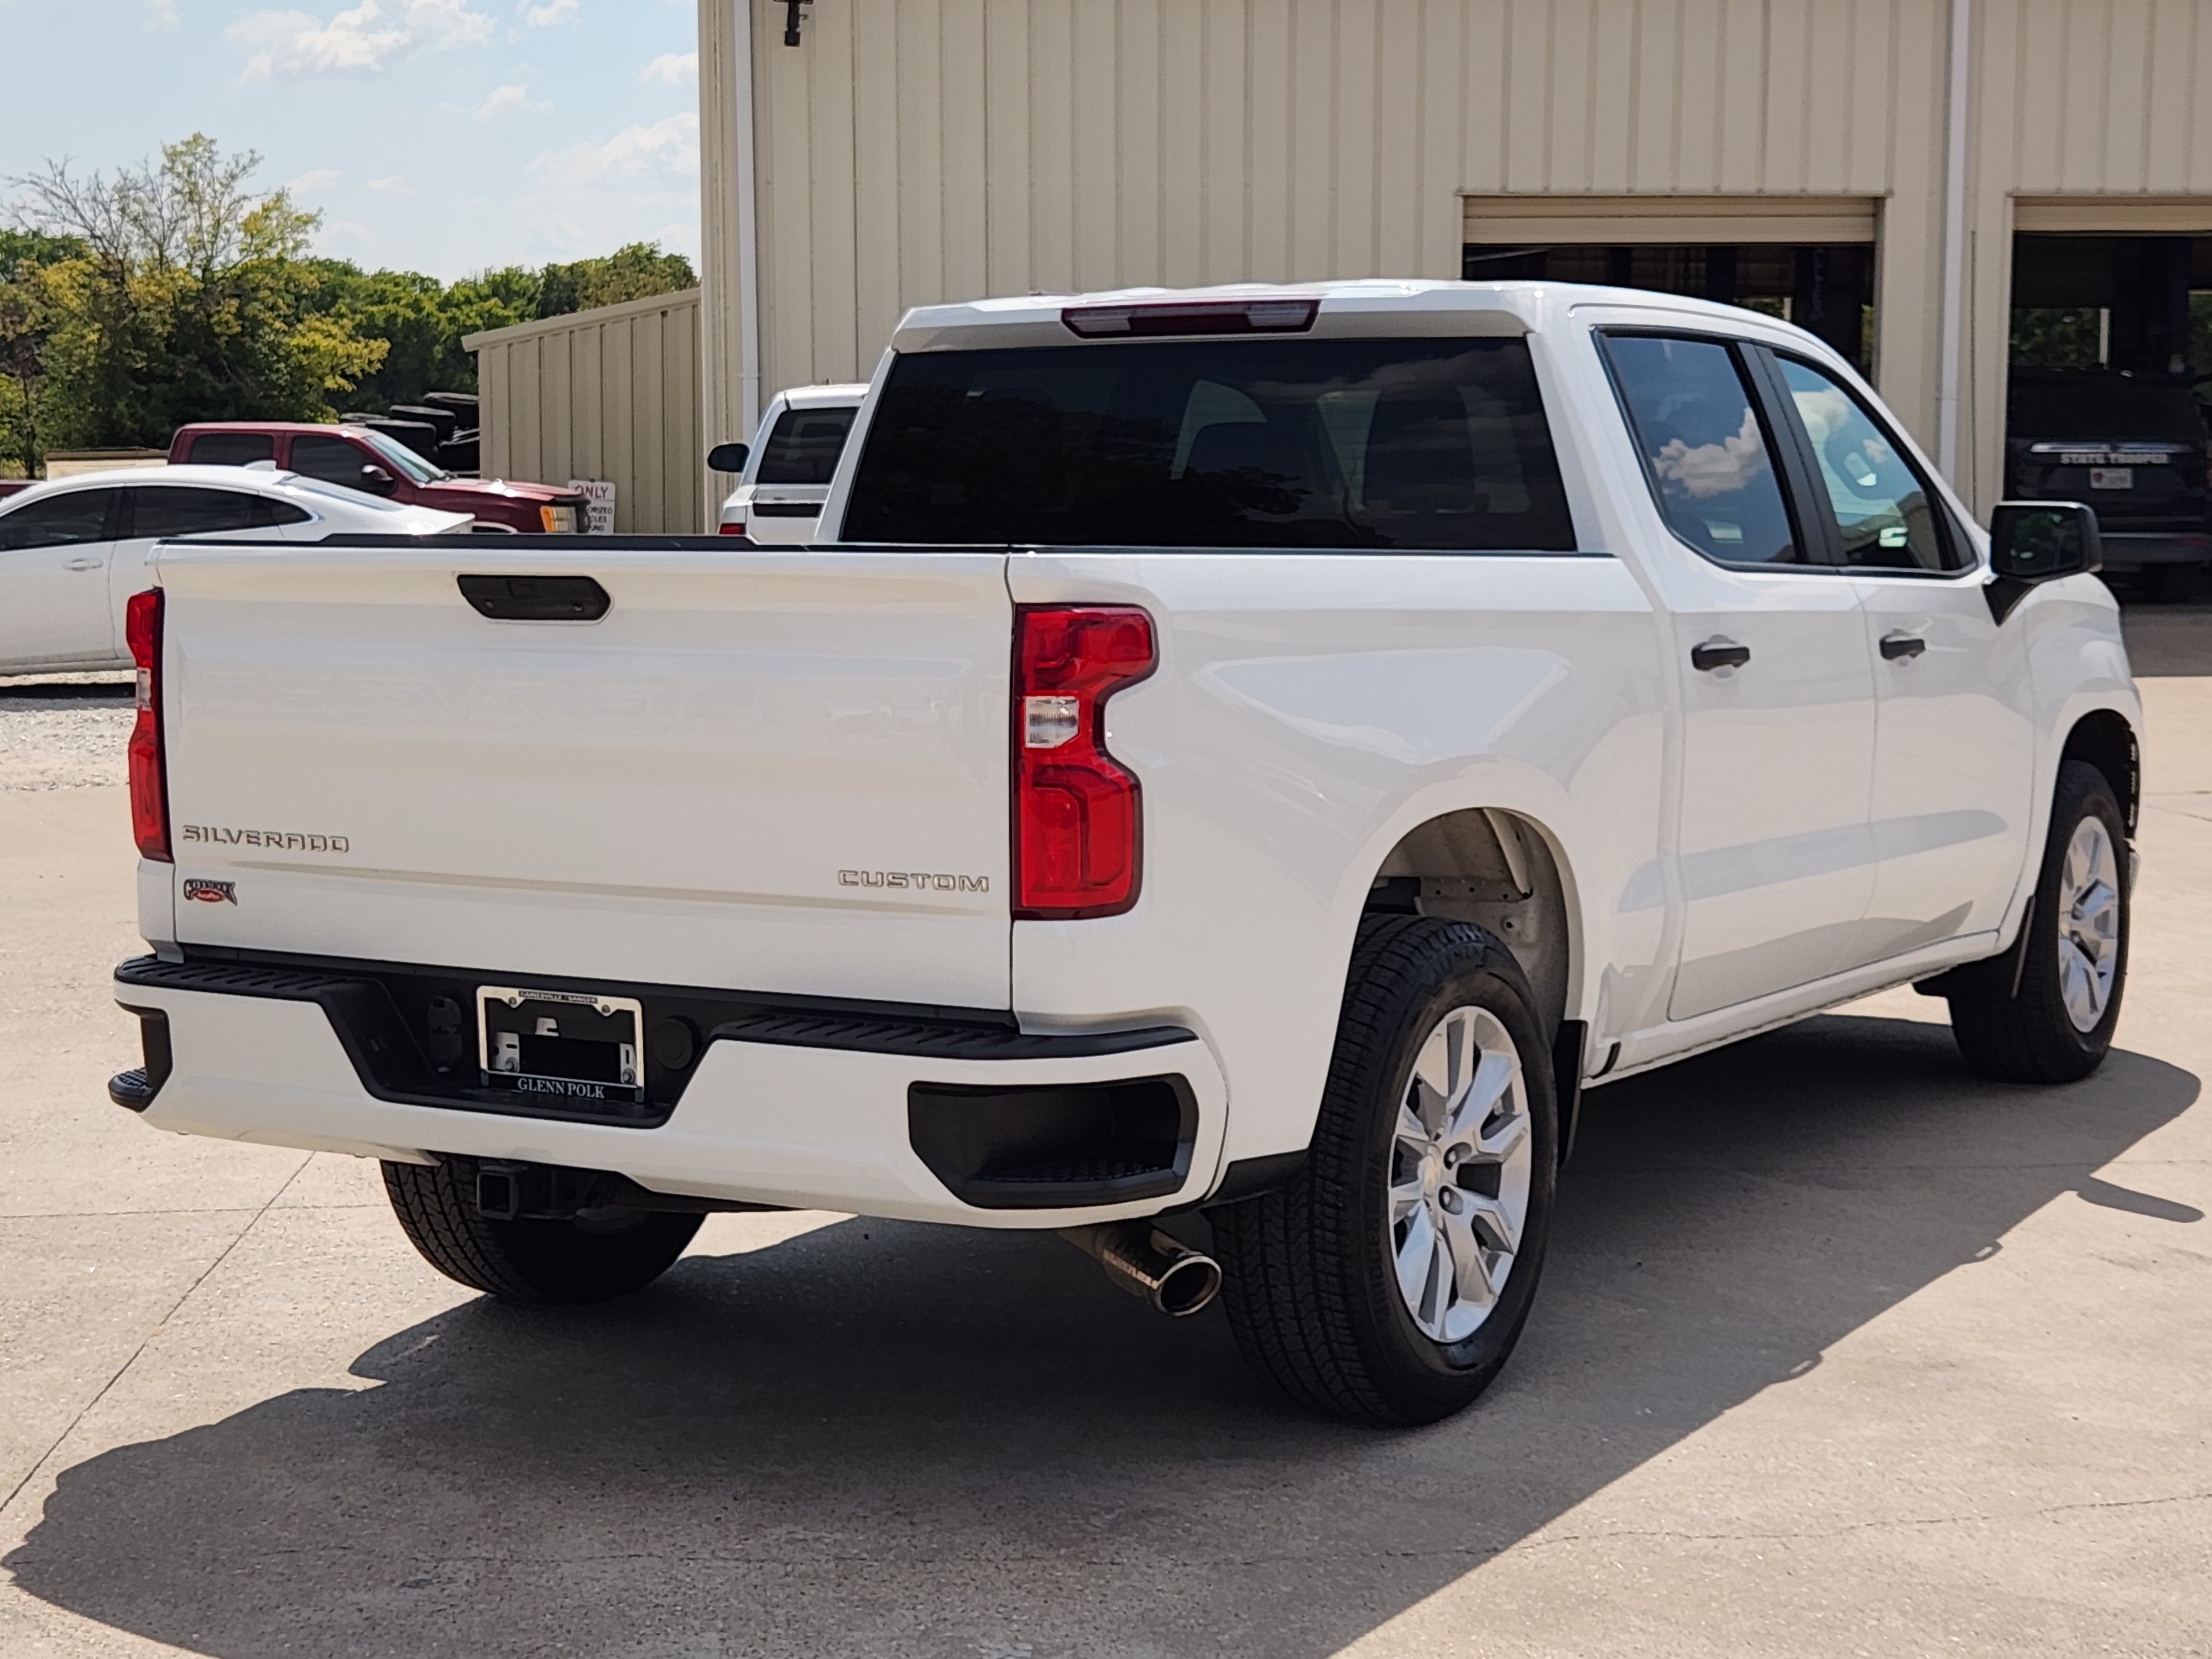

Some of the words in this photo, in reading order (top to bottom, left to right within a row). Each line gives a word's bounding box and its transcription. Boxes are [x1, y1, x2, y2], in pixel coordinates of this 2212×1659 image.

[575, 485, 609, 499] ONLY
[182, 825, 349, 853] SILVERADO
[838, 869, 989, 893] CUSTOM
[518, 1078, 565, 1094] GLENN
[567, 1084, 605, 1099] POLK
